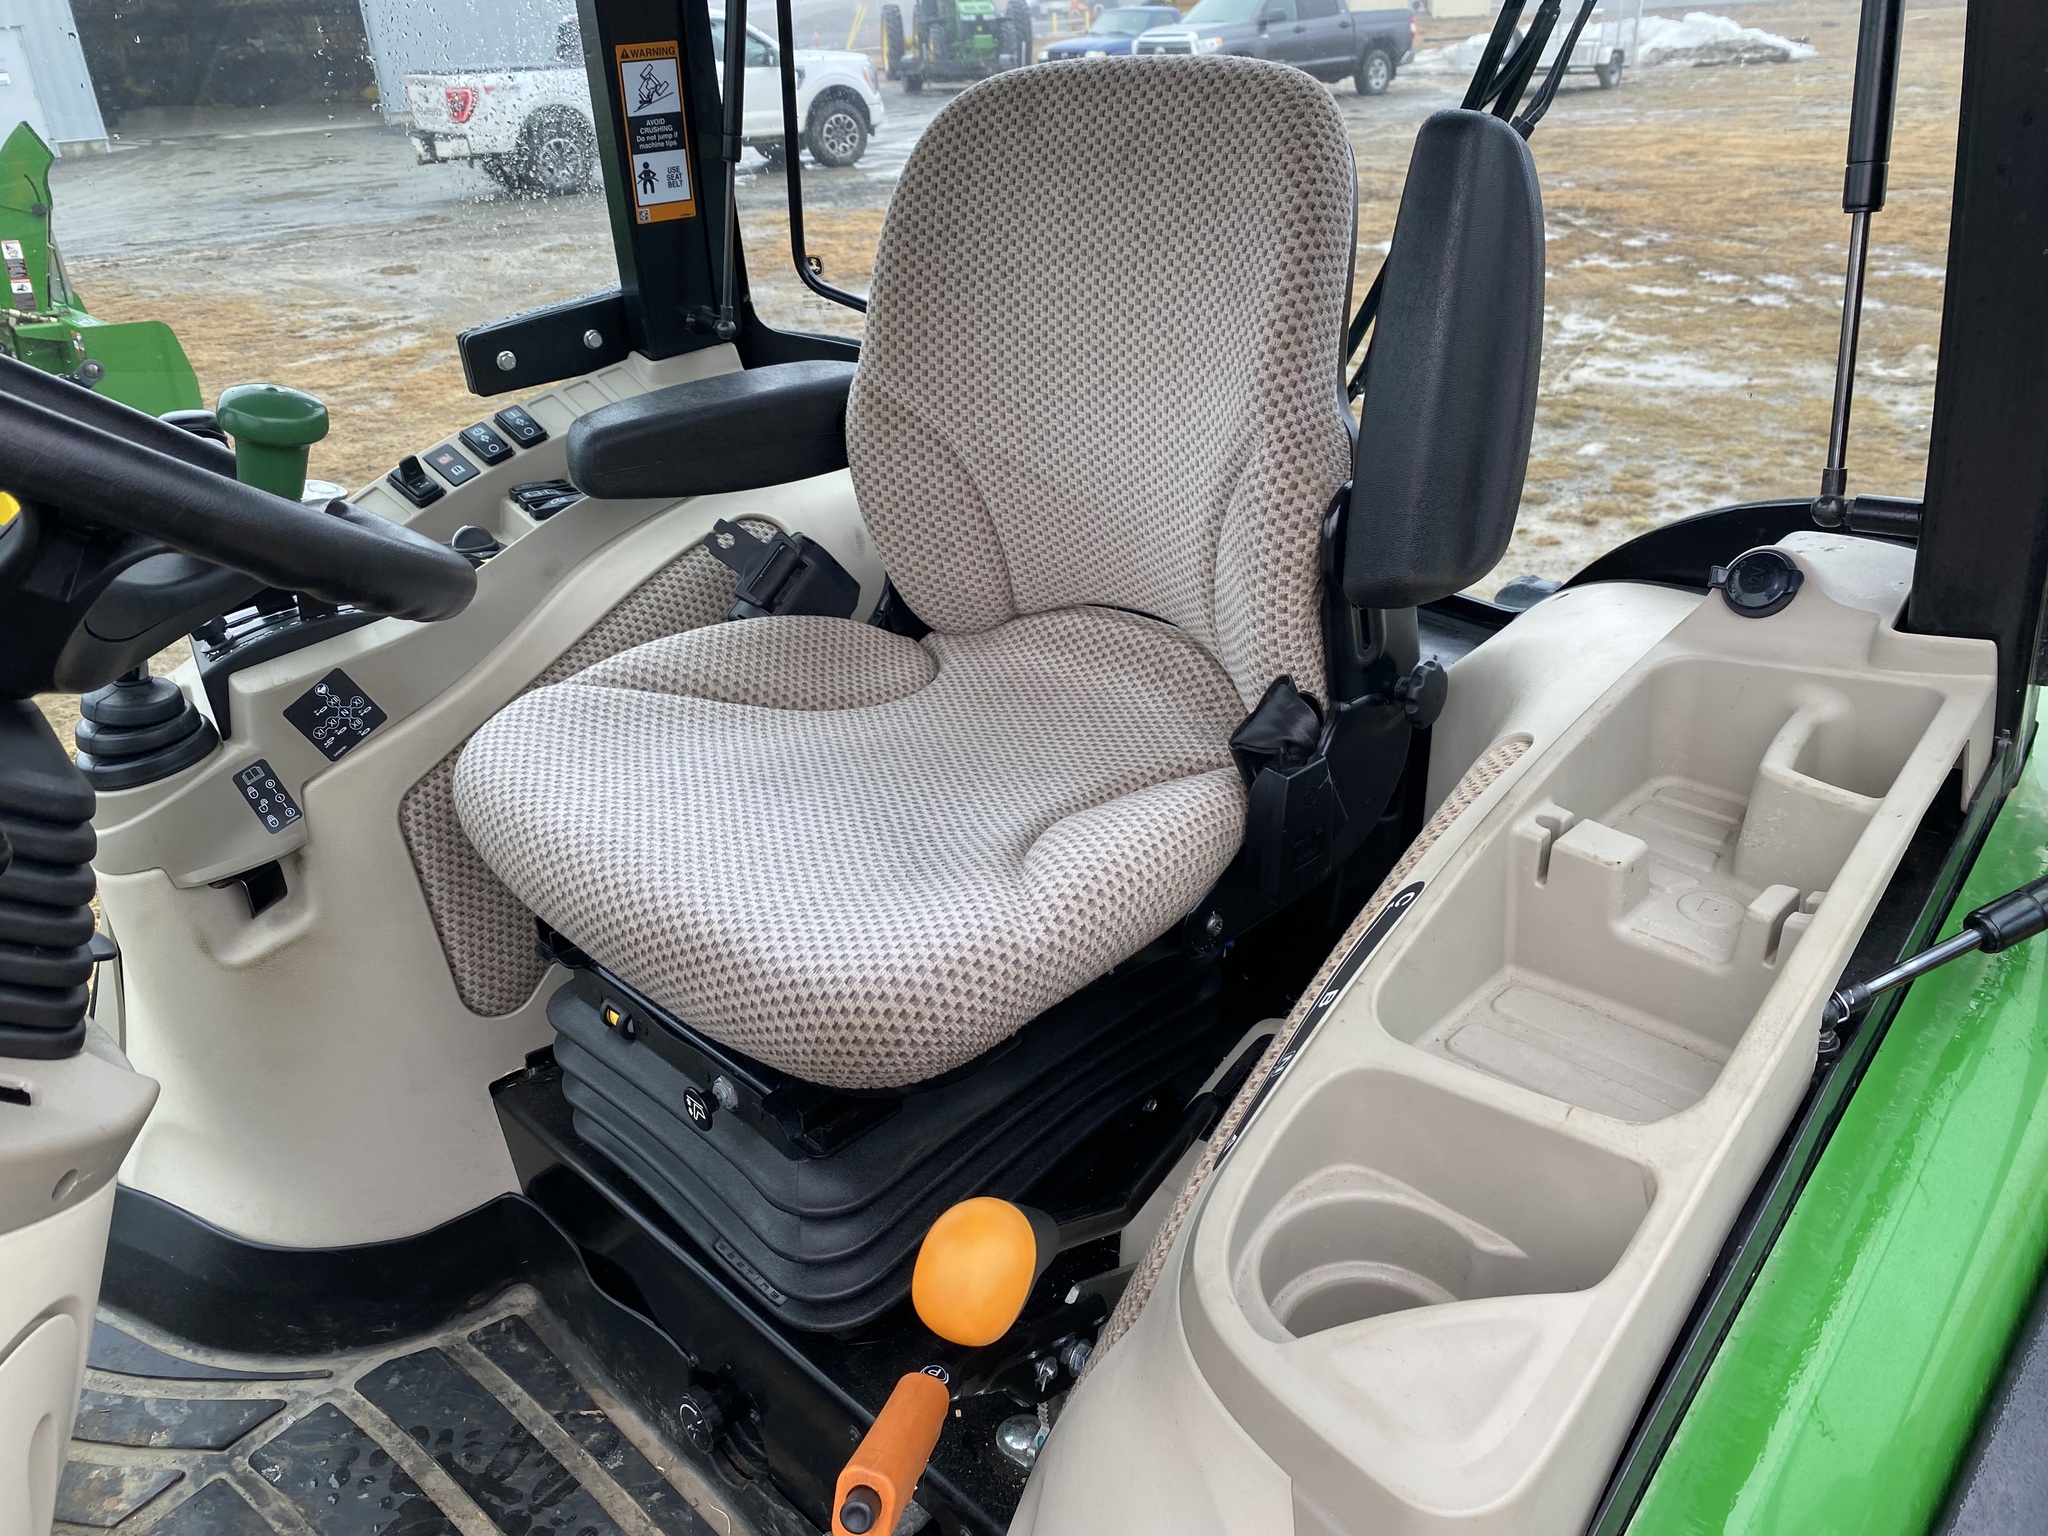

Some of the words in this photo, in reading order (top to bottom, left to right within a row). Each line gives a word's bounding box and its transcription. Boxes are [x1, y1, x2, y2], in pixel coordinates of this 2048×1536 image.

[630, 46, 676, 58] WARNING
[646, 118, 665, 126] AVOID
[640, 124, 673, 134] CRUSHING
[657, 132, 673, 141] jump
[639, 141, 665, 149] machine
[665, 139, 677, 148] tips
[667, 165, 680, 173] USE
[667, 172, 682, 181] SEAT
[667, 180, 683, 188] BELT
[1395, 892, 1415, 907] C
[1319, 989, 1339, 1007] B
